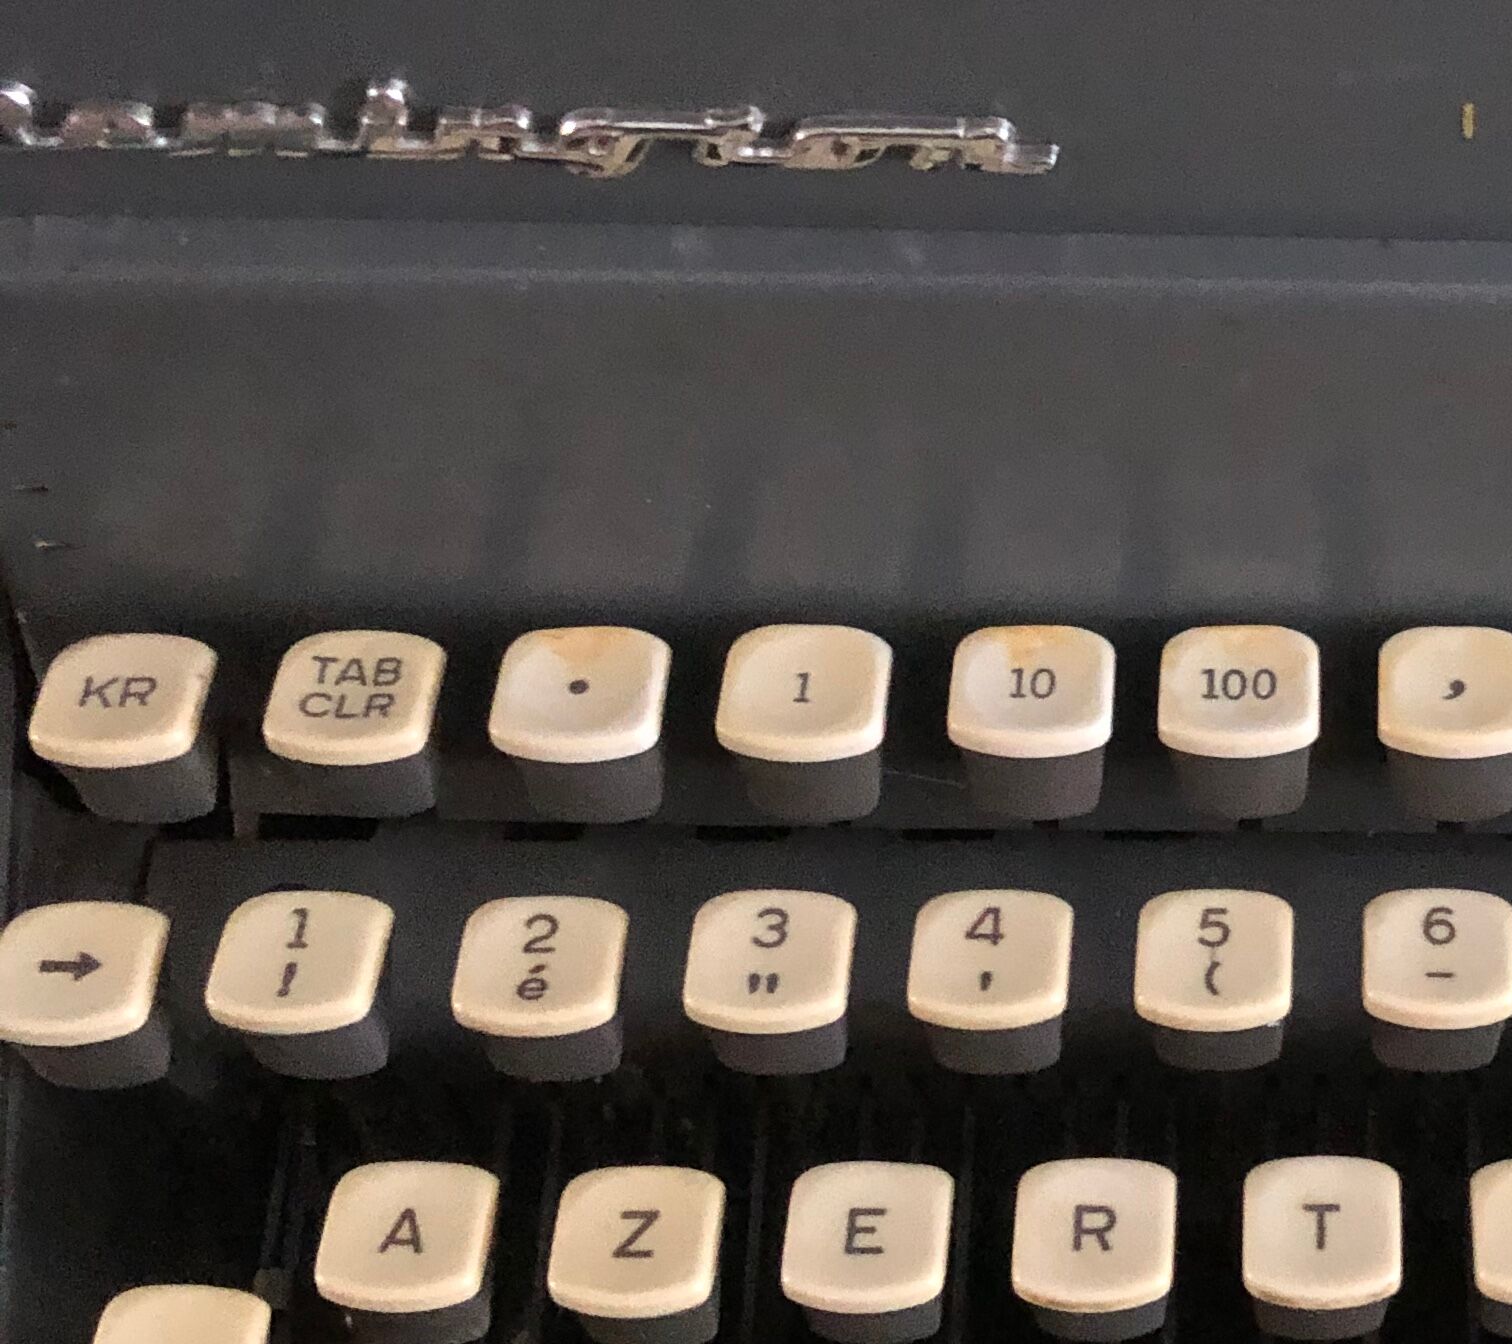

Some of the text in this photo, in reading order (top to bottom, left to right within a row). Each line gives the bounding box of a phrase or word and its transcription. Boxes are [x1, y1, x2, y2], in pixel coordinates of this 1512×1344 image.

[312, 655, 403, 688] TAB
[793, 672, 810, 704] 1
[1009, 667, 1057, 700] 10
[1202, 668, 1278, 701] 100
[78, 676, 158, 709] KR
[299, 692, 396, 720] CLR
[286, 907, 309, 950] 1
[522, 913, 560, 955] 2
[752, 907, 789, 950] 3
[964, 906, 1005, 947] 4
[1197, 907, 1232, 950] 5
[1422, 906, 1457, 946] 6
[276, 961, 298, 998] !
[515, 963, 549, 1002] é
[378, 1207, 424, 1255] A
[612, 1209, 660, 1259] Z
[843, 1207, 887, 1256] E
[1072, 1204, 1117, 1252] R
[1302, 1203, 1341, 1251] T
